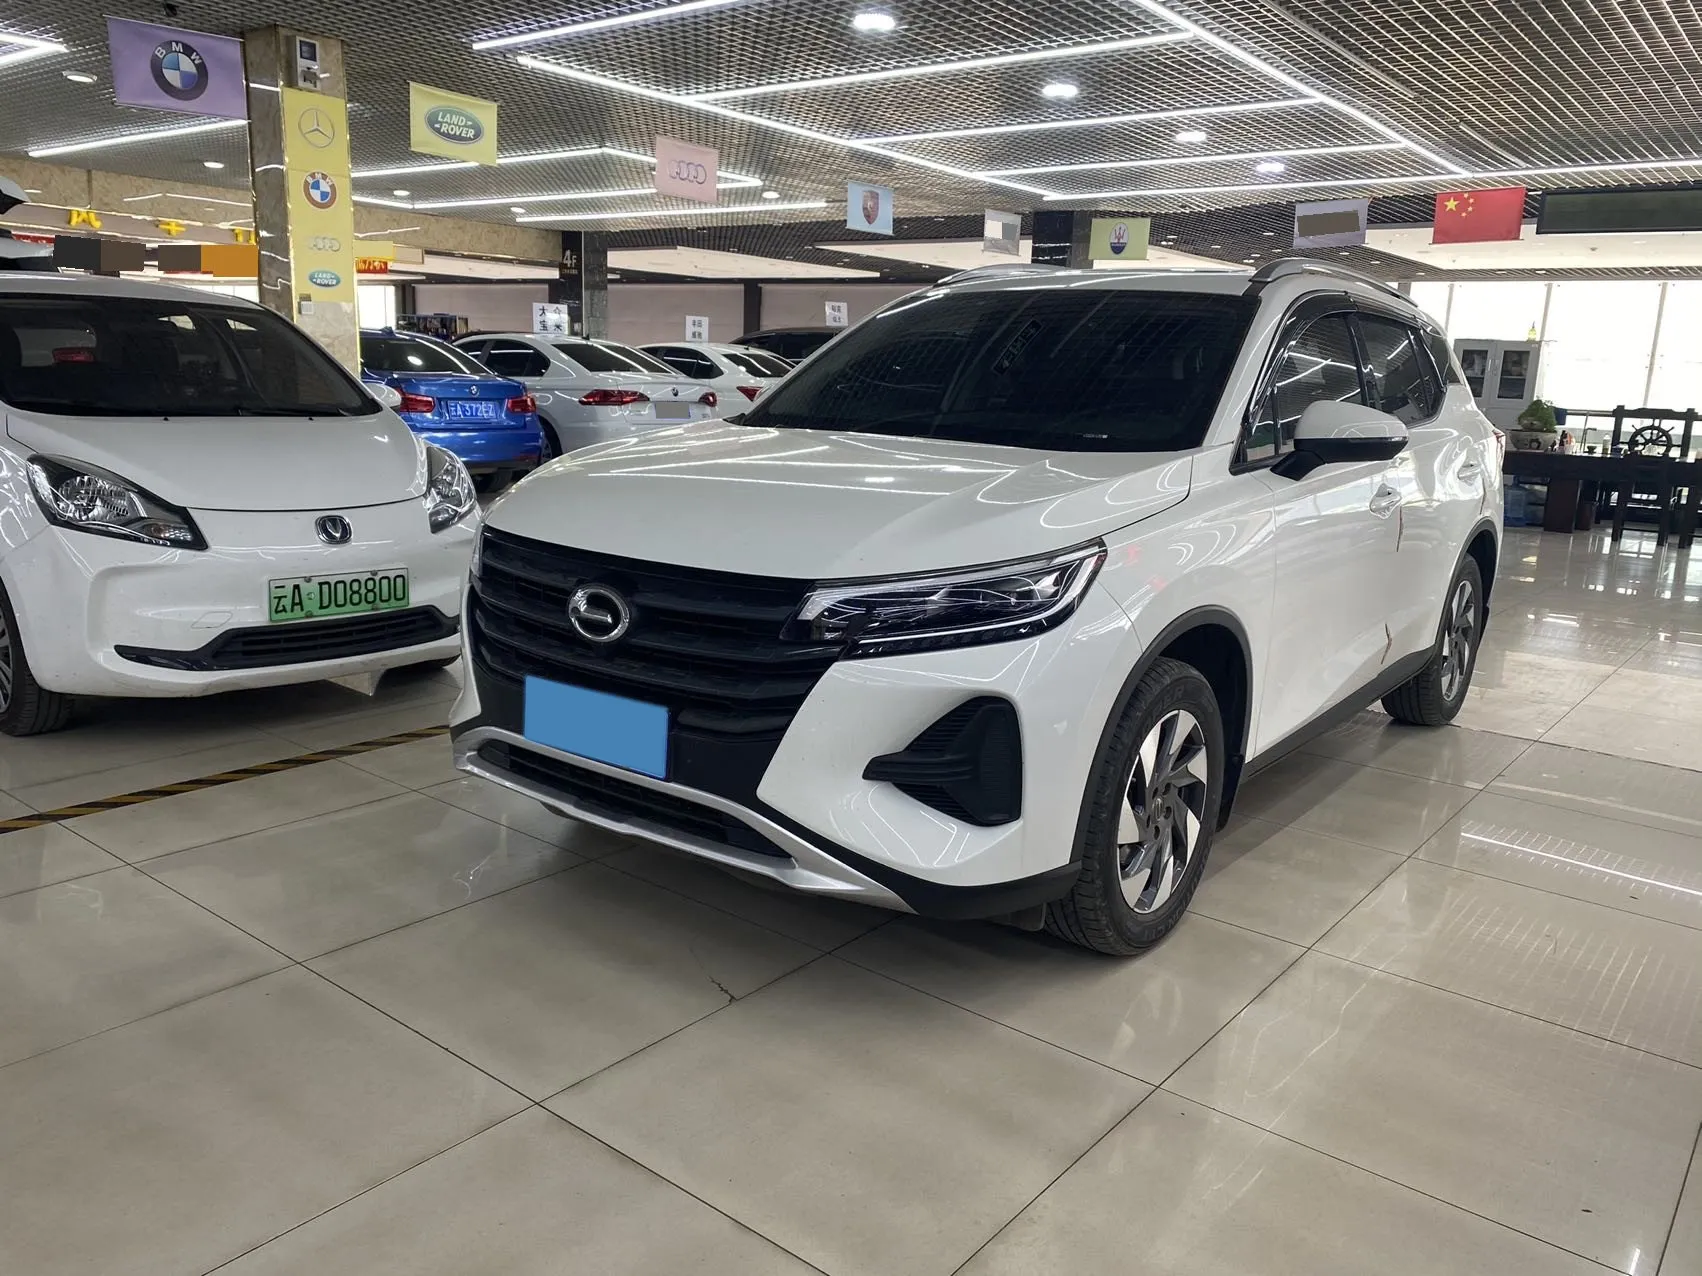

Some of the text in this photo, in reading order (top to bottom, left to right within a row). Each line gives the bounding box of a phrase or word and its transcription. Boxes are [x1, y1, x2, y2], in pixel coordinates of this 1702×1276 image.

[155, 41, 202, 65] BMW
[440, 123, 475, 139] ROVER
[563, 249, 577, 268] 4F
